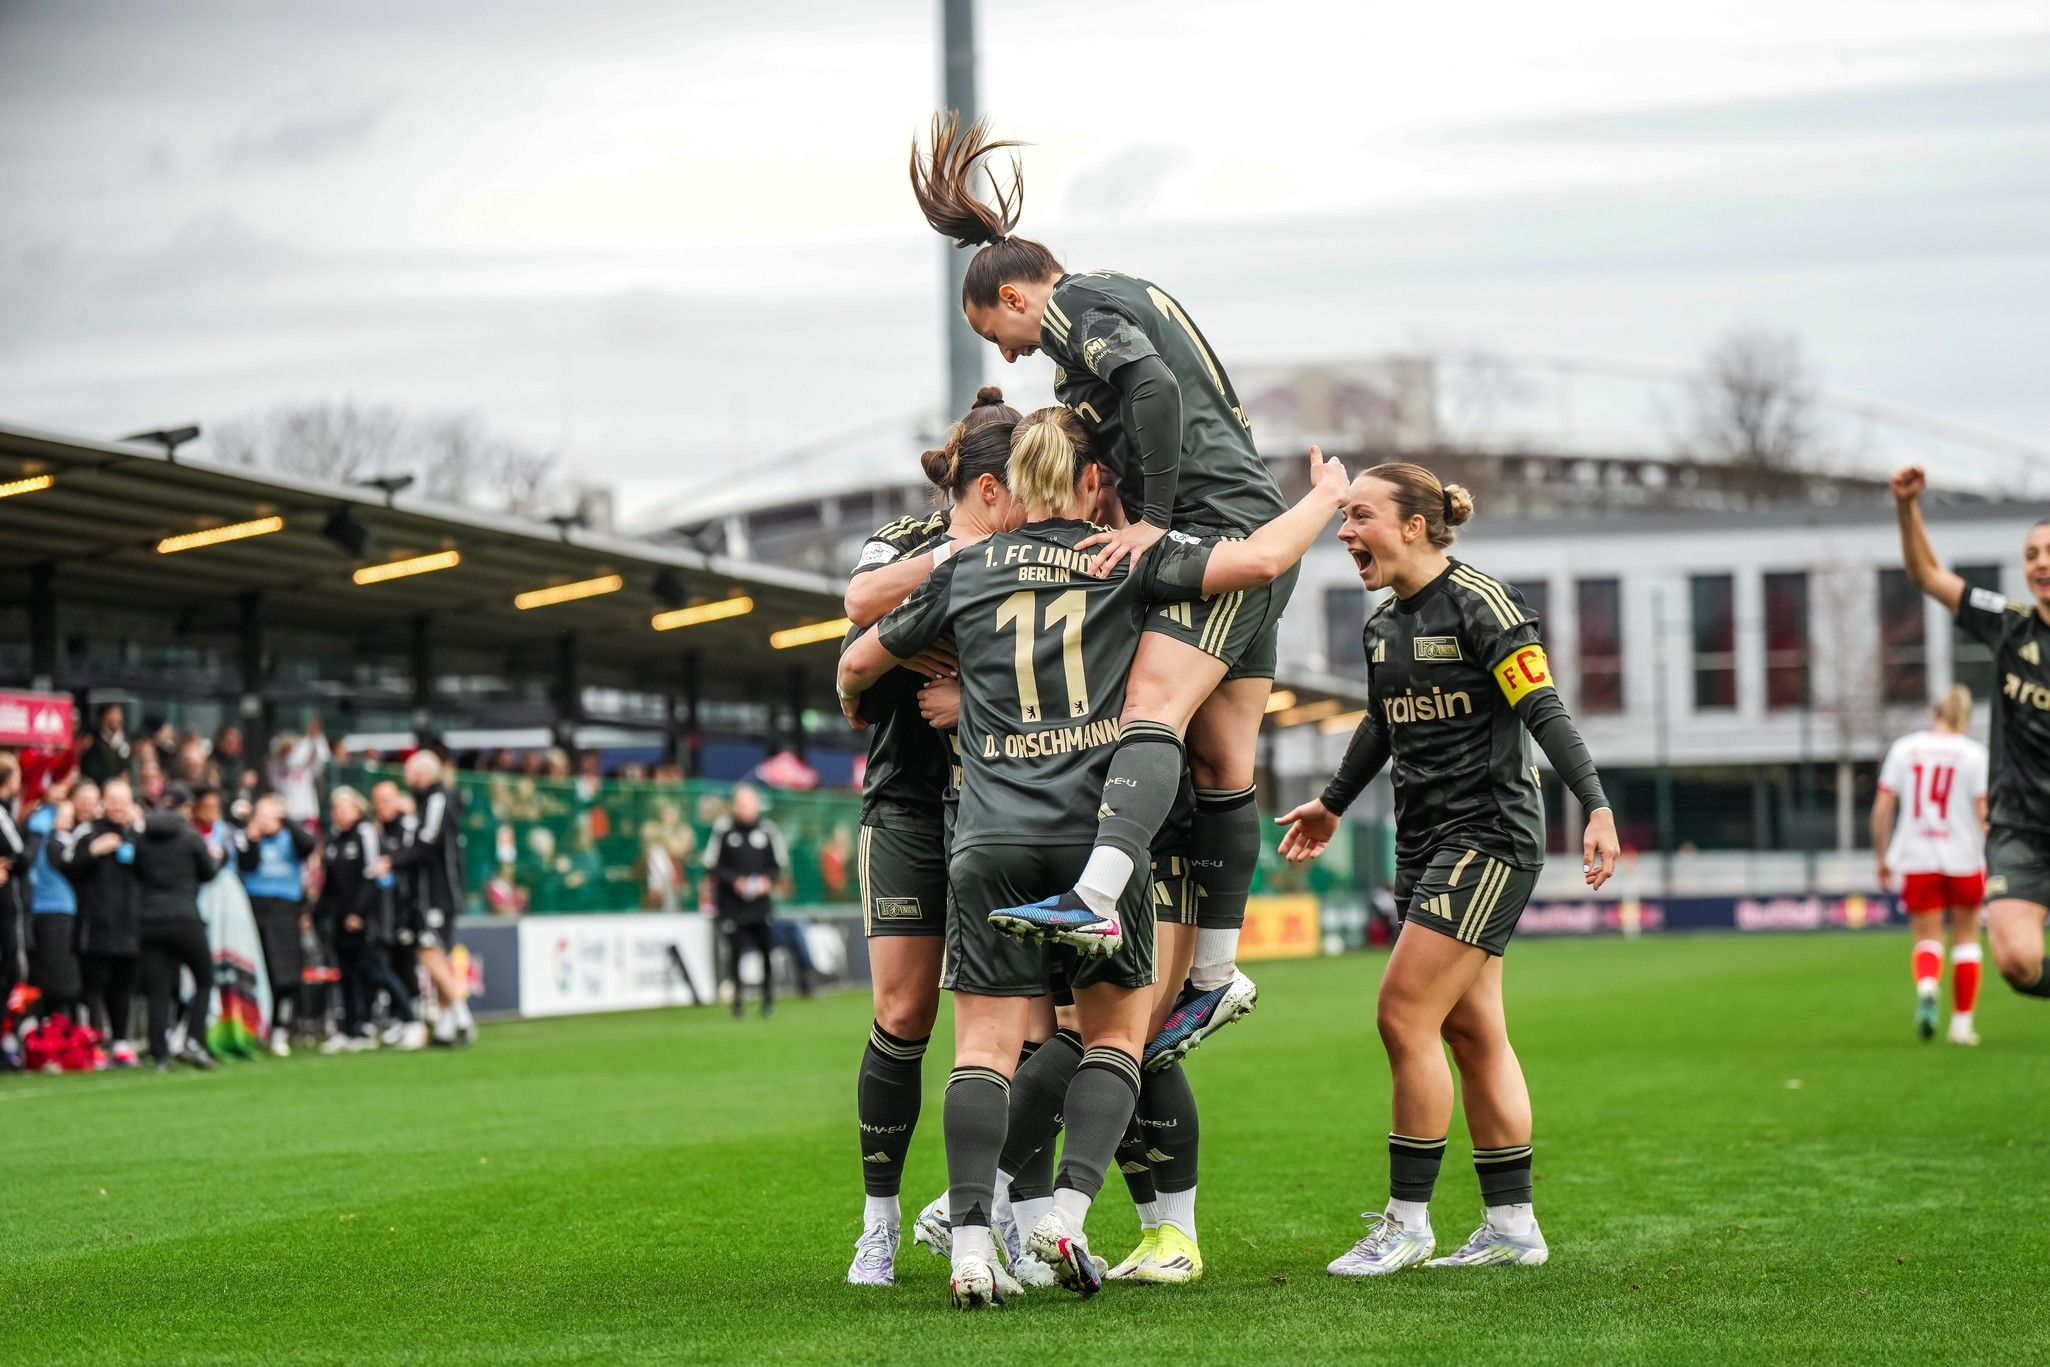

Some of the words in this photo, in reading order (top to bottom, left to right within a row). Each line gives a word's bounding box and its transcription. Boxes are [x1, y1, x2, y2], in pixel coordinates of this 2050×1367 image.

[985, 545, 998, 568] 1.
[1003, 544, 1033, 565] FC
[1037, 546, 1102, 578] UNIO
[1018, 566, 1071, 583] BERLIN
[996, 589, 1087, 723] 11
[1383, 686, 1472, 724] raisin
[983, 734, 1000, 758] D.
[1005, 717, 1120, 758] ORSCHMANN
[1909, 763, 1955, 820] 14
